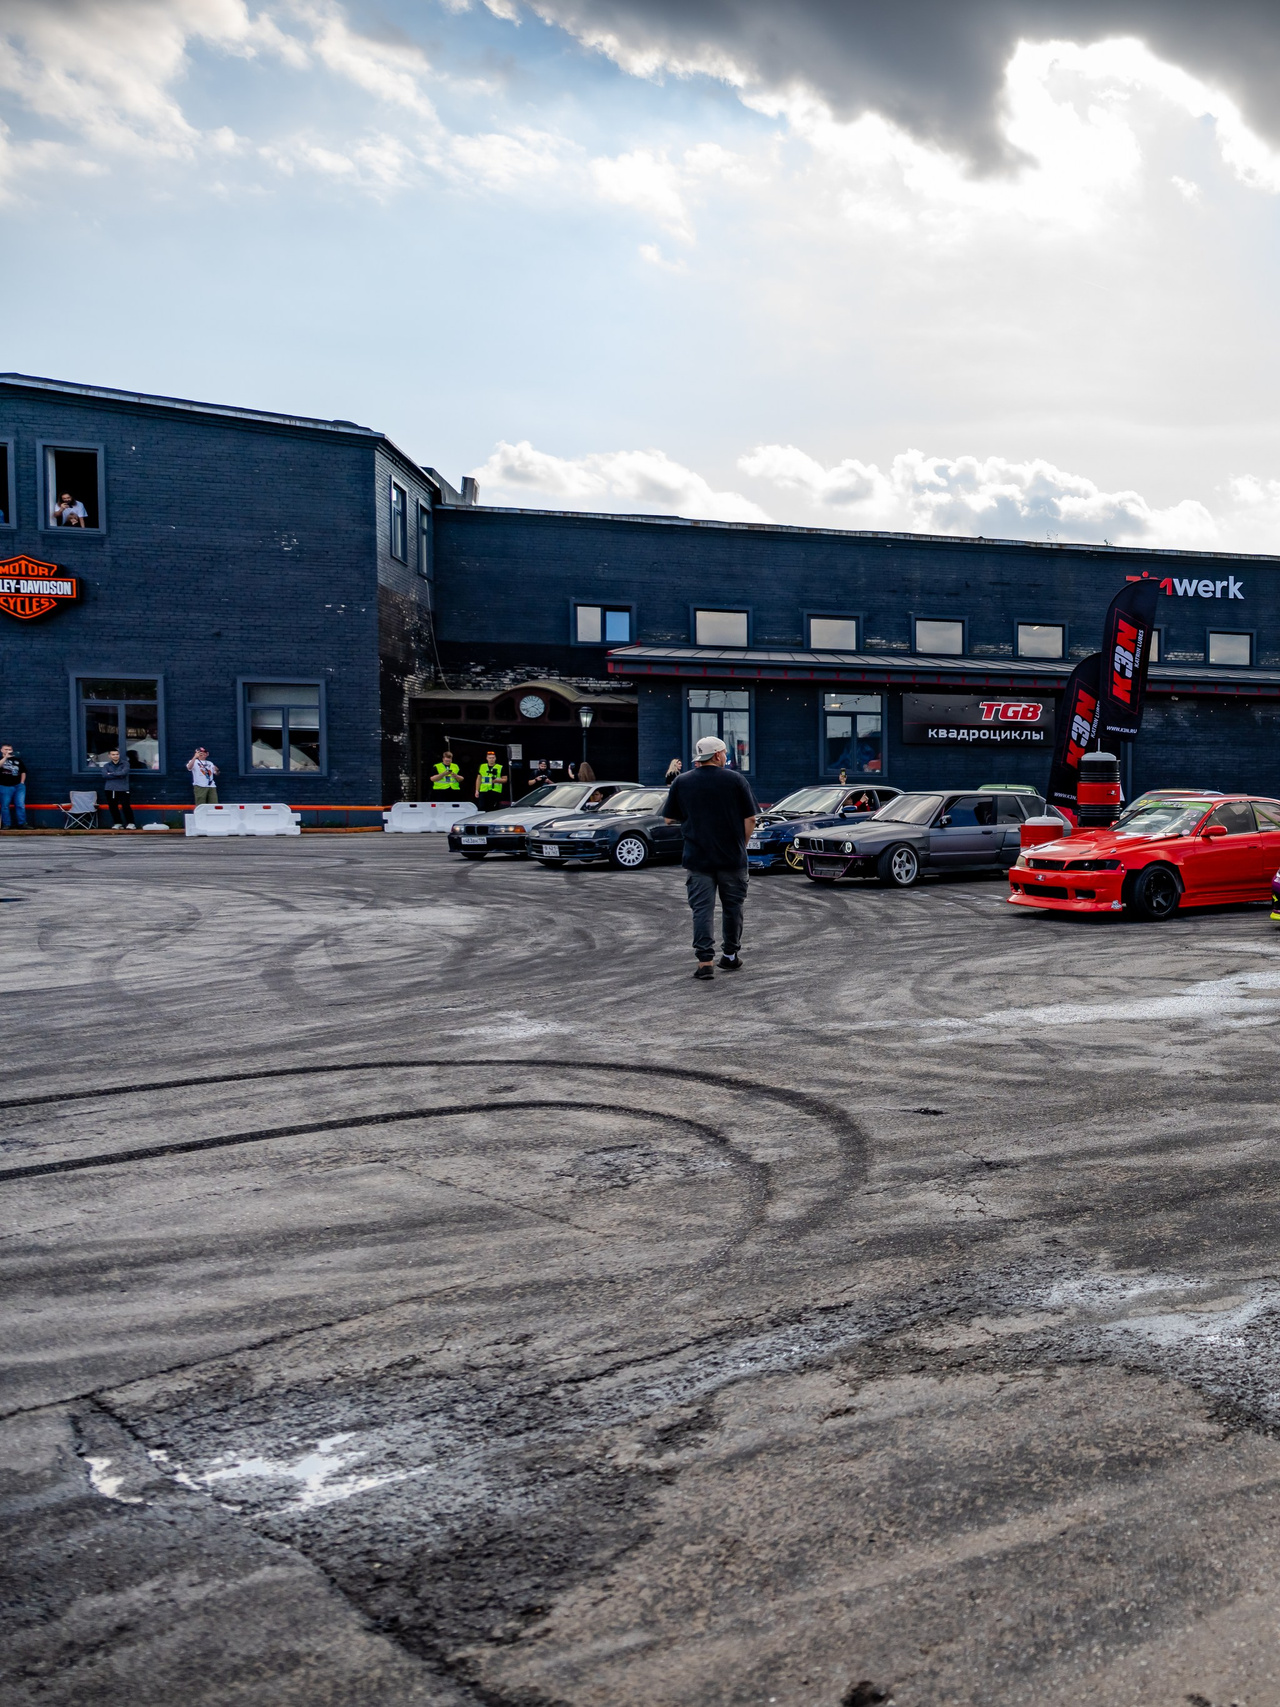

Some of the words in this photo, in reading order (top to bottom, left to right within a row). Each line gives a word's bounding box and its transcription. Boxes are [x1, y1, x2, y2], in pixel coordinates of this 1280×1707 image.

[0, 560, 49, 576] MOTOR
[0, 597, 50, 615] CYCLES
[1136, 629, 1144, 648] LUBES
[979, 701, 1043, 722] TGB
[928, 728, 1044, 741] квадроциклы
